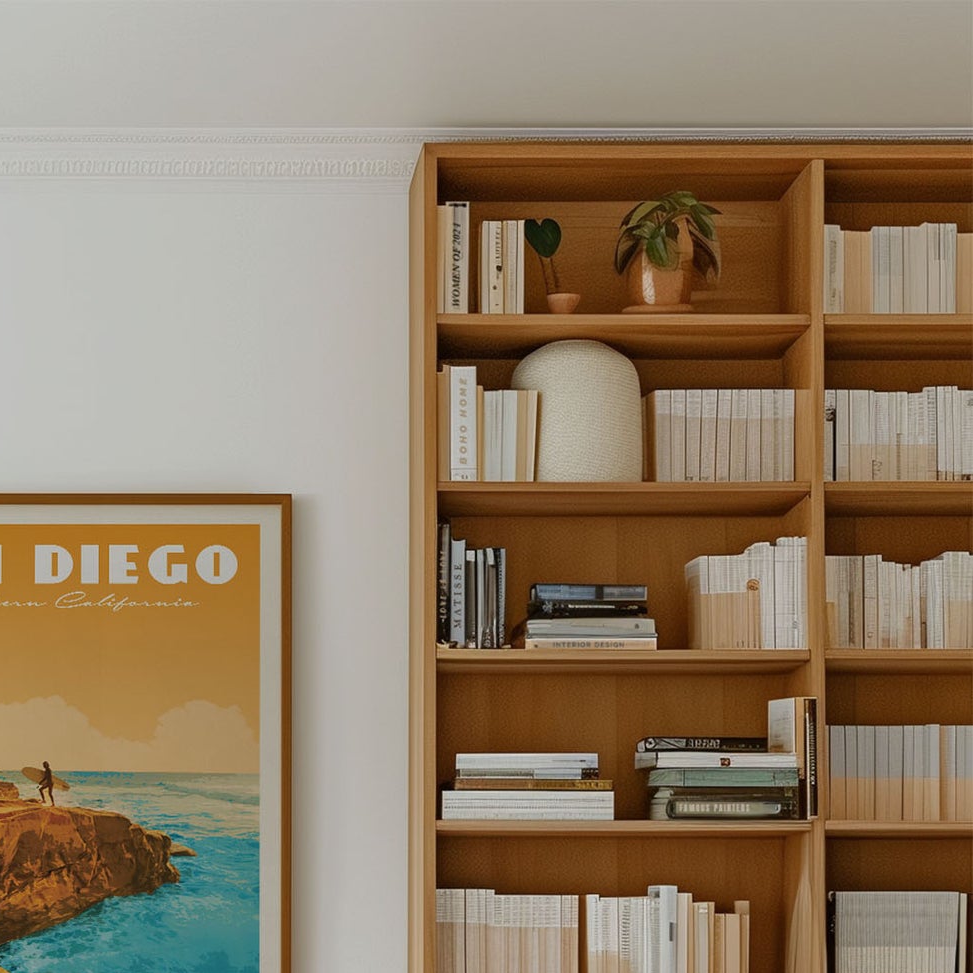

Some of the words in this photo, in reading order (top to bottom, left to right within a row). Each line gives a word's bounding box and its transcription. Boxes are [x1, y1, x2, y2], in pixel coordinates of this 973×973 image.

[452, 247, 461, 262] OF
[452, 264, 461, 307] WOMEN
[459, 377, 467, 418] HOME
[459, 425, 467, 465] BOHO
[34, 544, 238, 584] DIEGO
[54, 590, 201, 612] California
[453, 563, 463, 629] MATISSE
[679, 803, 710, 812] FAMOUS
[713, 803, 750, 812] PAINTERS
